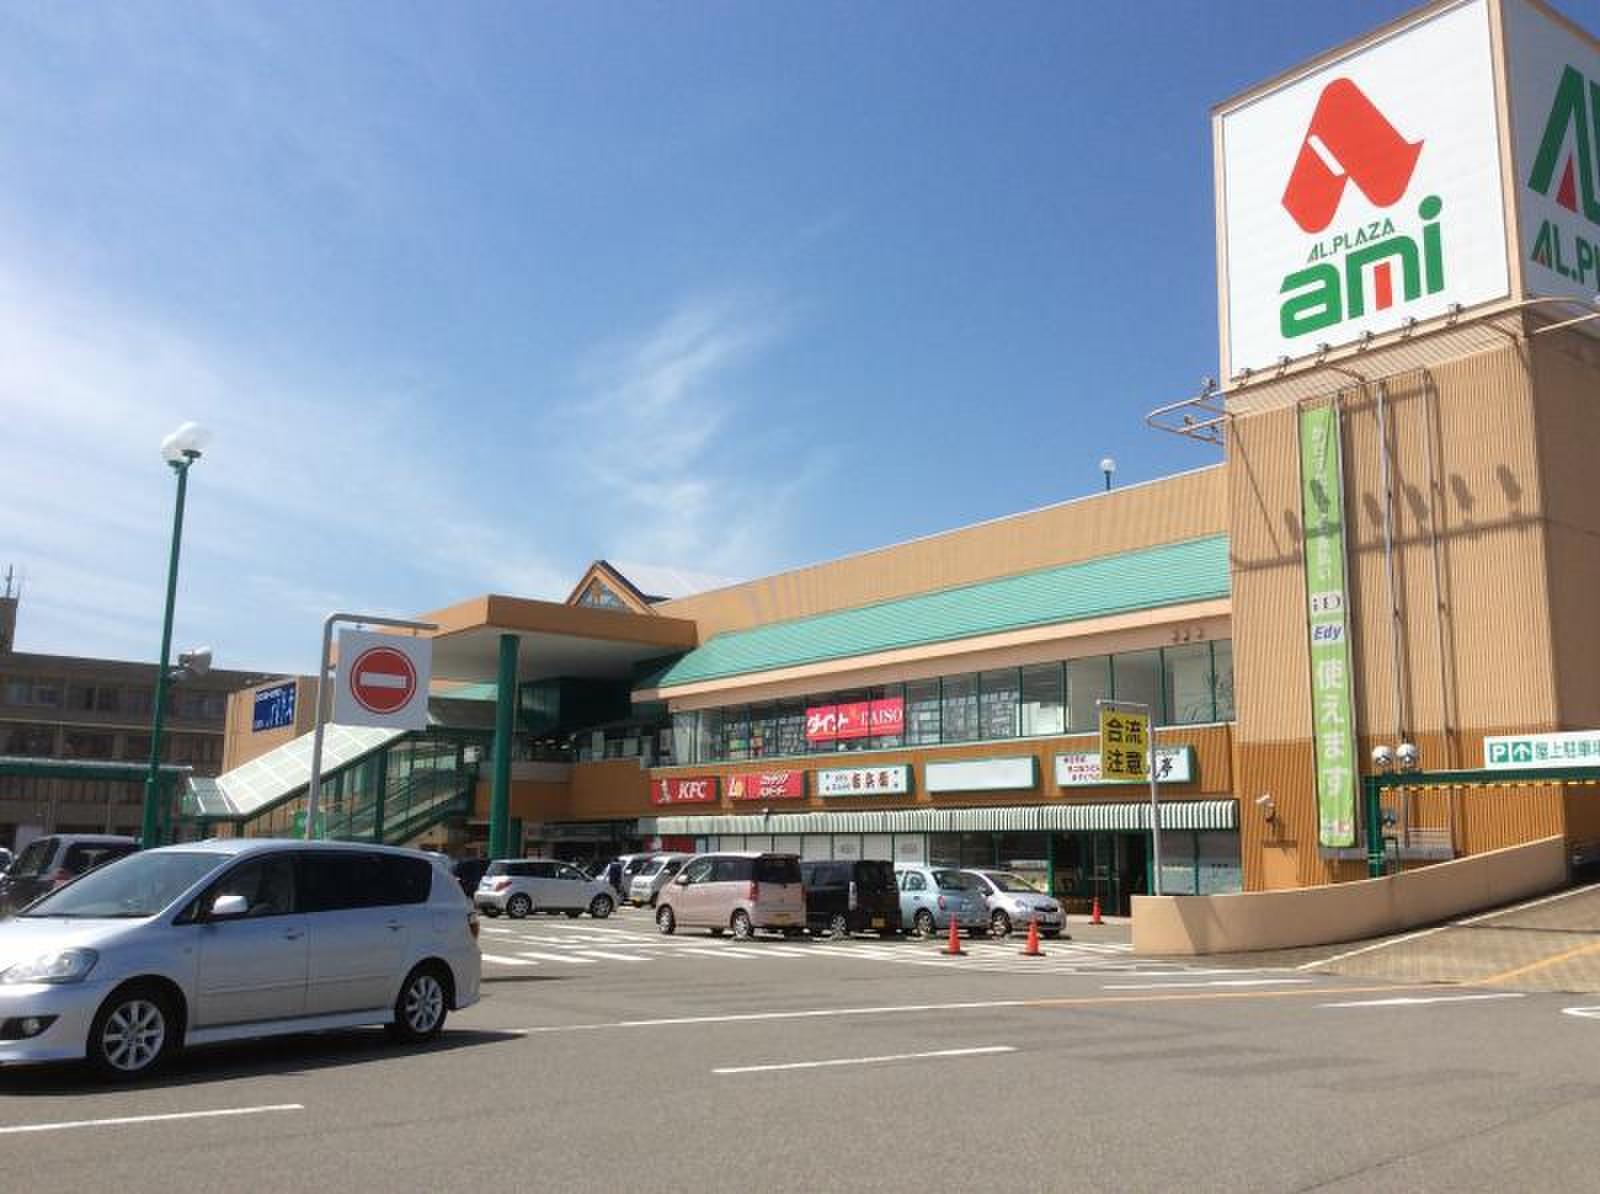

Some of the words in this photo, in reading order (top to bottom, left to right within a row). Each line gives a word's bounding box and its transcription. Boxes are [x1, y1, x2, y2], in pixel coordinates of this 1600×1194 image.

[1307, 217, 1395, 263] AL.PLAZA
[1279, 196, 1444, 339] ami
[1313, 624, 1342, 641] Edy
[1106, 717, 1143, 745] 合流
[1318, 659, 1347, 796] 使えます
[1106, 748, 1143, 775] 注意
[678, 781, 707, 799] KFC
